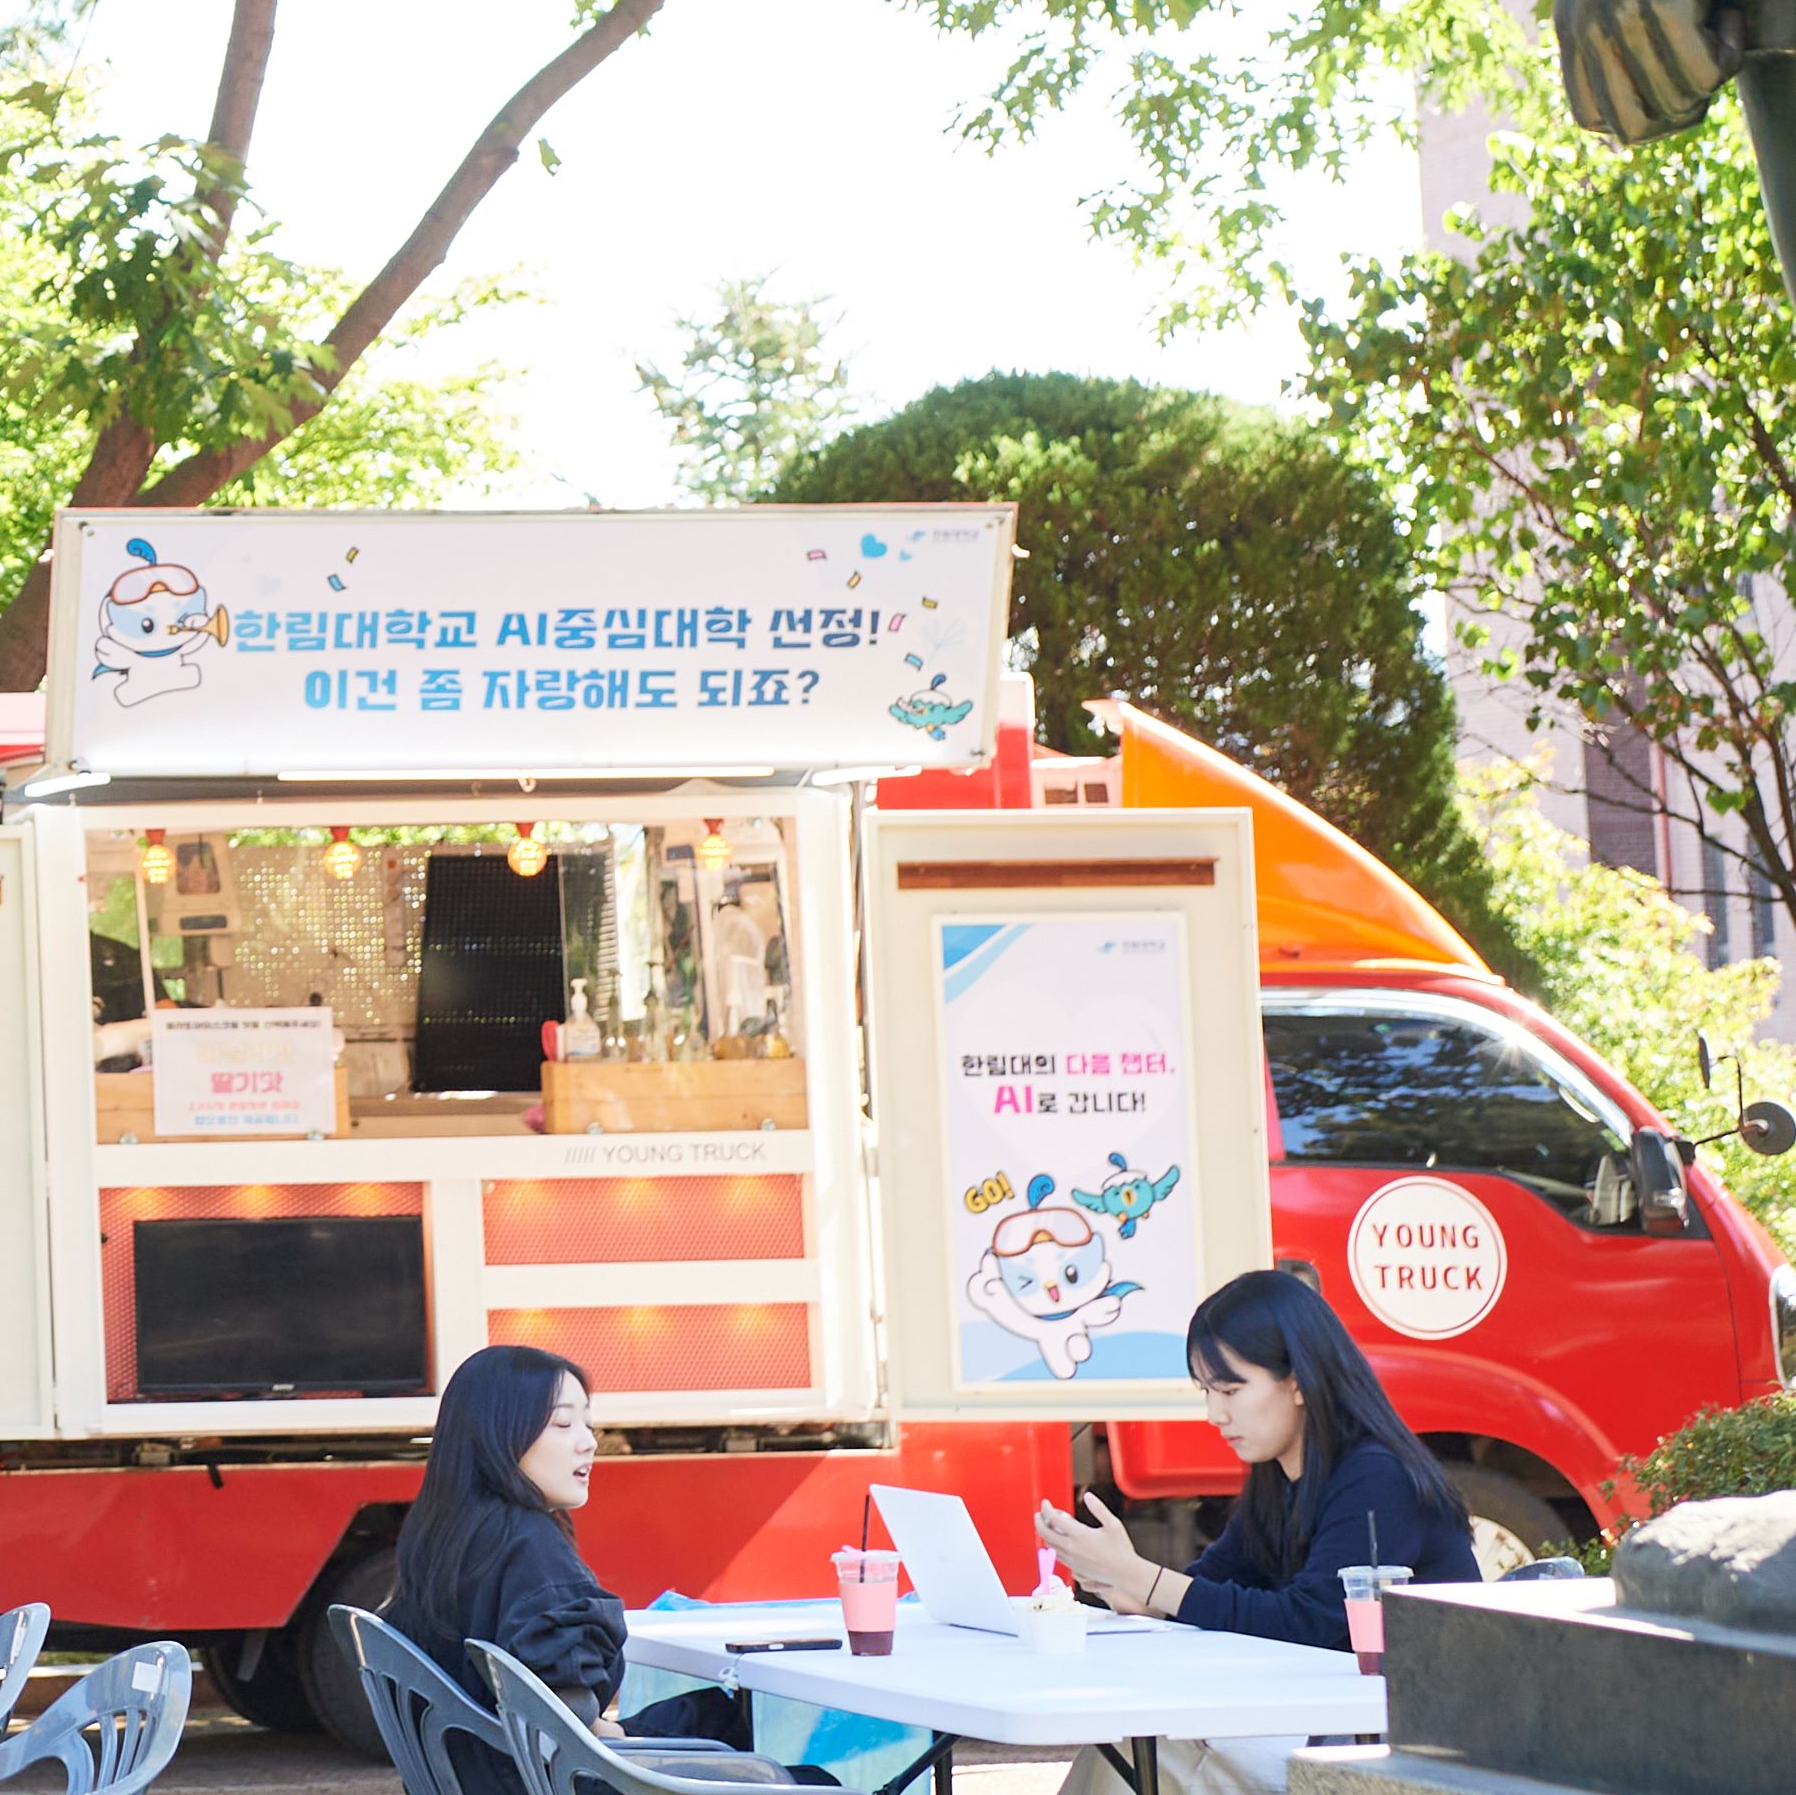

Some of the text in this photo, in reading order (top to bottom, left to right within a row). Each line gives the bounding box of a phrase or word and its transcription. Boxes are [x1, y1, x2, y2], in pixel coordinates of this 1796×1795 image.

[234, 609, 882, 651] 한림대학교 AI중심대학 선정!
[304, 668, 819, 711] 이건 좀 자랑해도 되죠?
[962, 1054, 1056, 1076] 한림대의
[1066, 1054, 1110, 1075] 다음
[994, 1085, 1146, 1114] AI로 갑니다!
[602, 1143, 766, 1163] YOUNG TRUCK
[965, 1172, 1012, 1214] GO!
[1372, 1226, 1479, 1250] YOUNG
[1375, 1264, 1483, 1291] TRUCK
